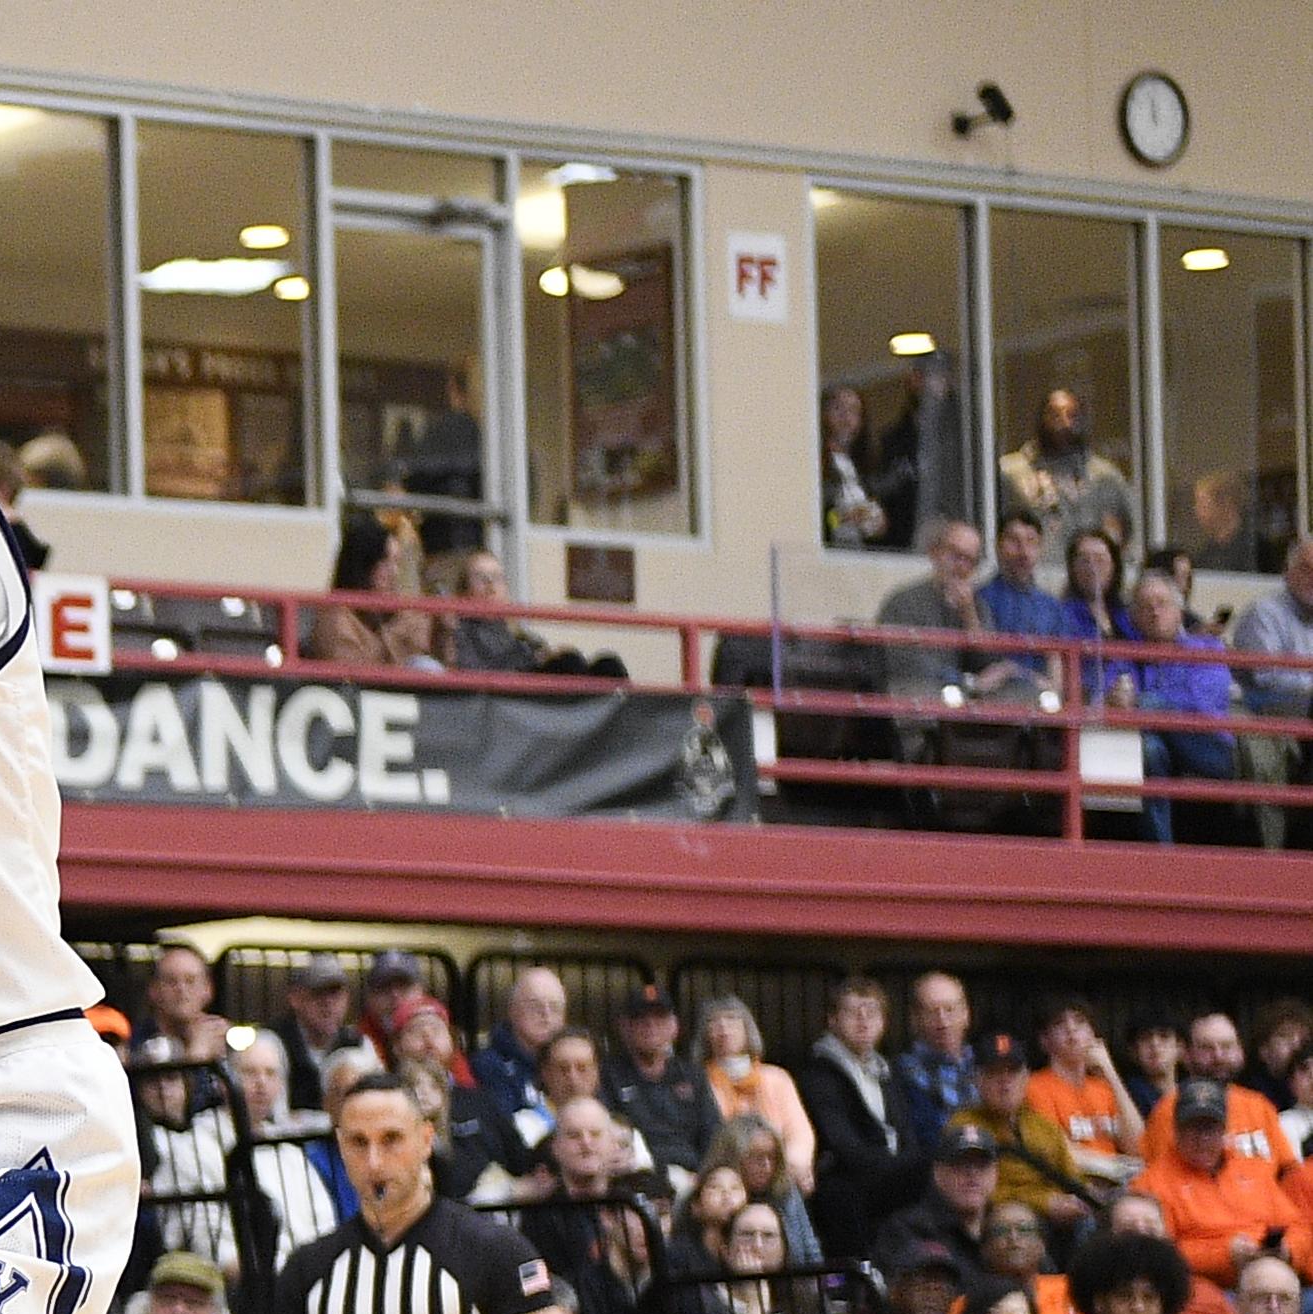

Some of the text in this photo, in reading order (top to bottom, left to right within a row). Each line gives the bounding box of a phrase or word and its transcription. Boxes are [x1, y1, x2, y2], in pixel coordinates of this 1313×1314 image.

[736, 254, 778, 299] FF
[50, 594, 95, 662] E
[51, 679, 450, 803] DANCE.
